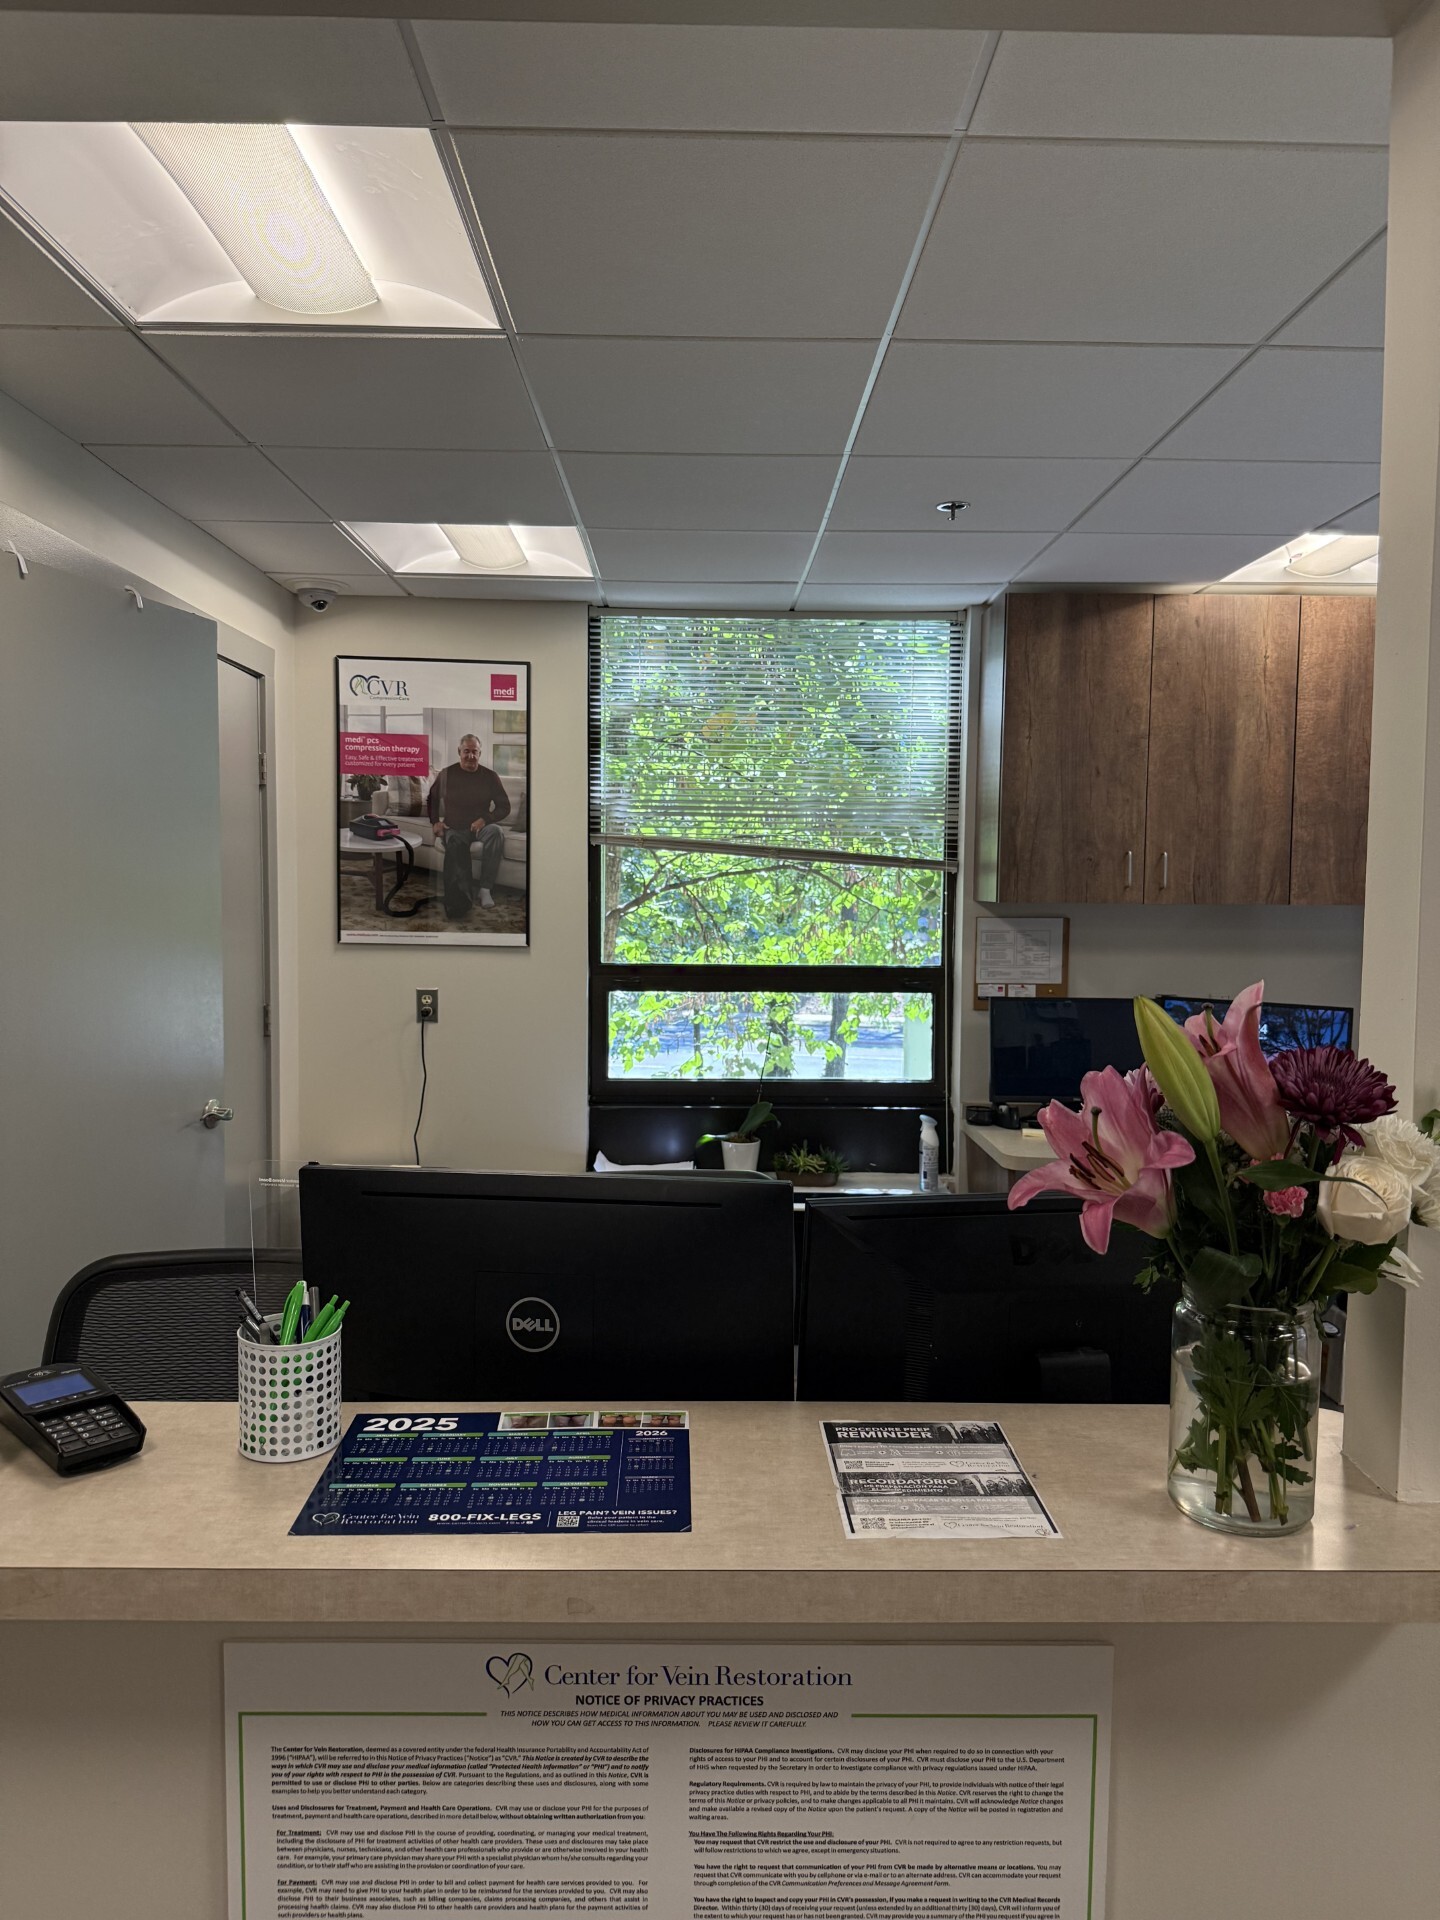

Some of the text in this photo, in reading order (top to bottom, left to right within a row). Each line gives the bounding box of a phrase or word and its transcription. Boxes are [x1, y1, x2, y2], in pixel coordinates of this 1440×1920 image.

[368, 680, 410, 696] CVR
[494, 687, 514, 696] medi
[392, 745, 420, 754] therapy
[512, 1317, 554, 1332] DELL
[362, 1418, 459, 1431] 2025
[428, 1513, 542, 1522] 800-FIX-LEGS
[544, 1664, 853, 1685] Center for Vein Restoration
[575, 1694, 764, 1706] NOTICE OF PRIVACY PRACTICES
